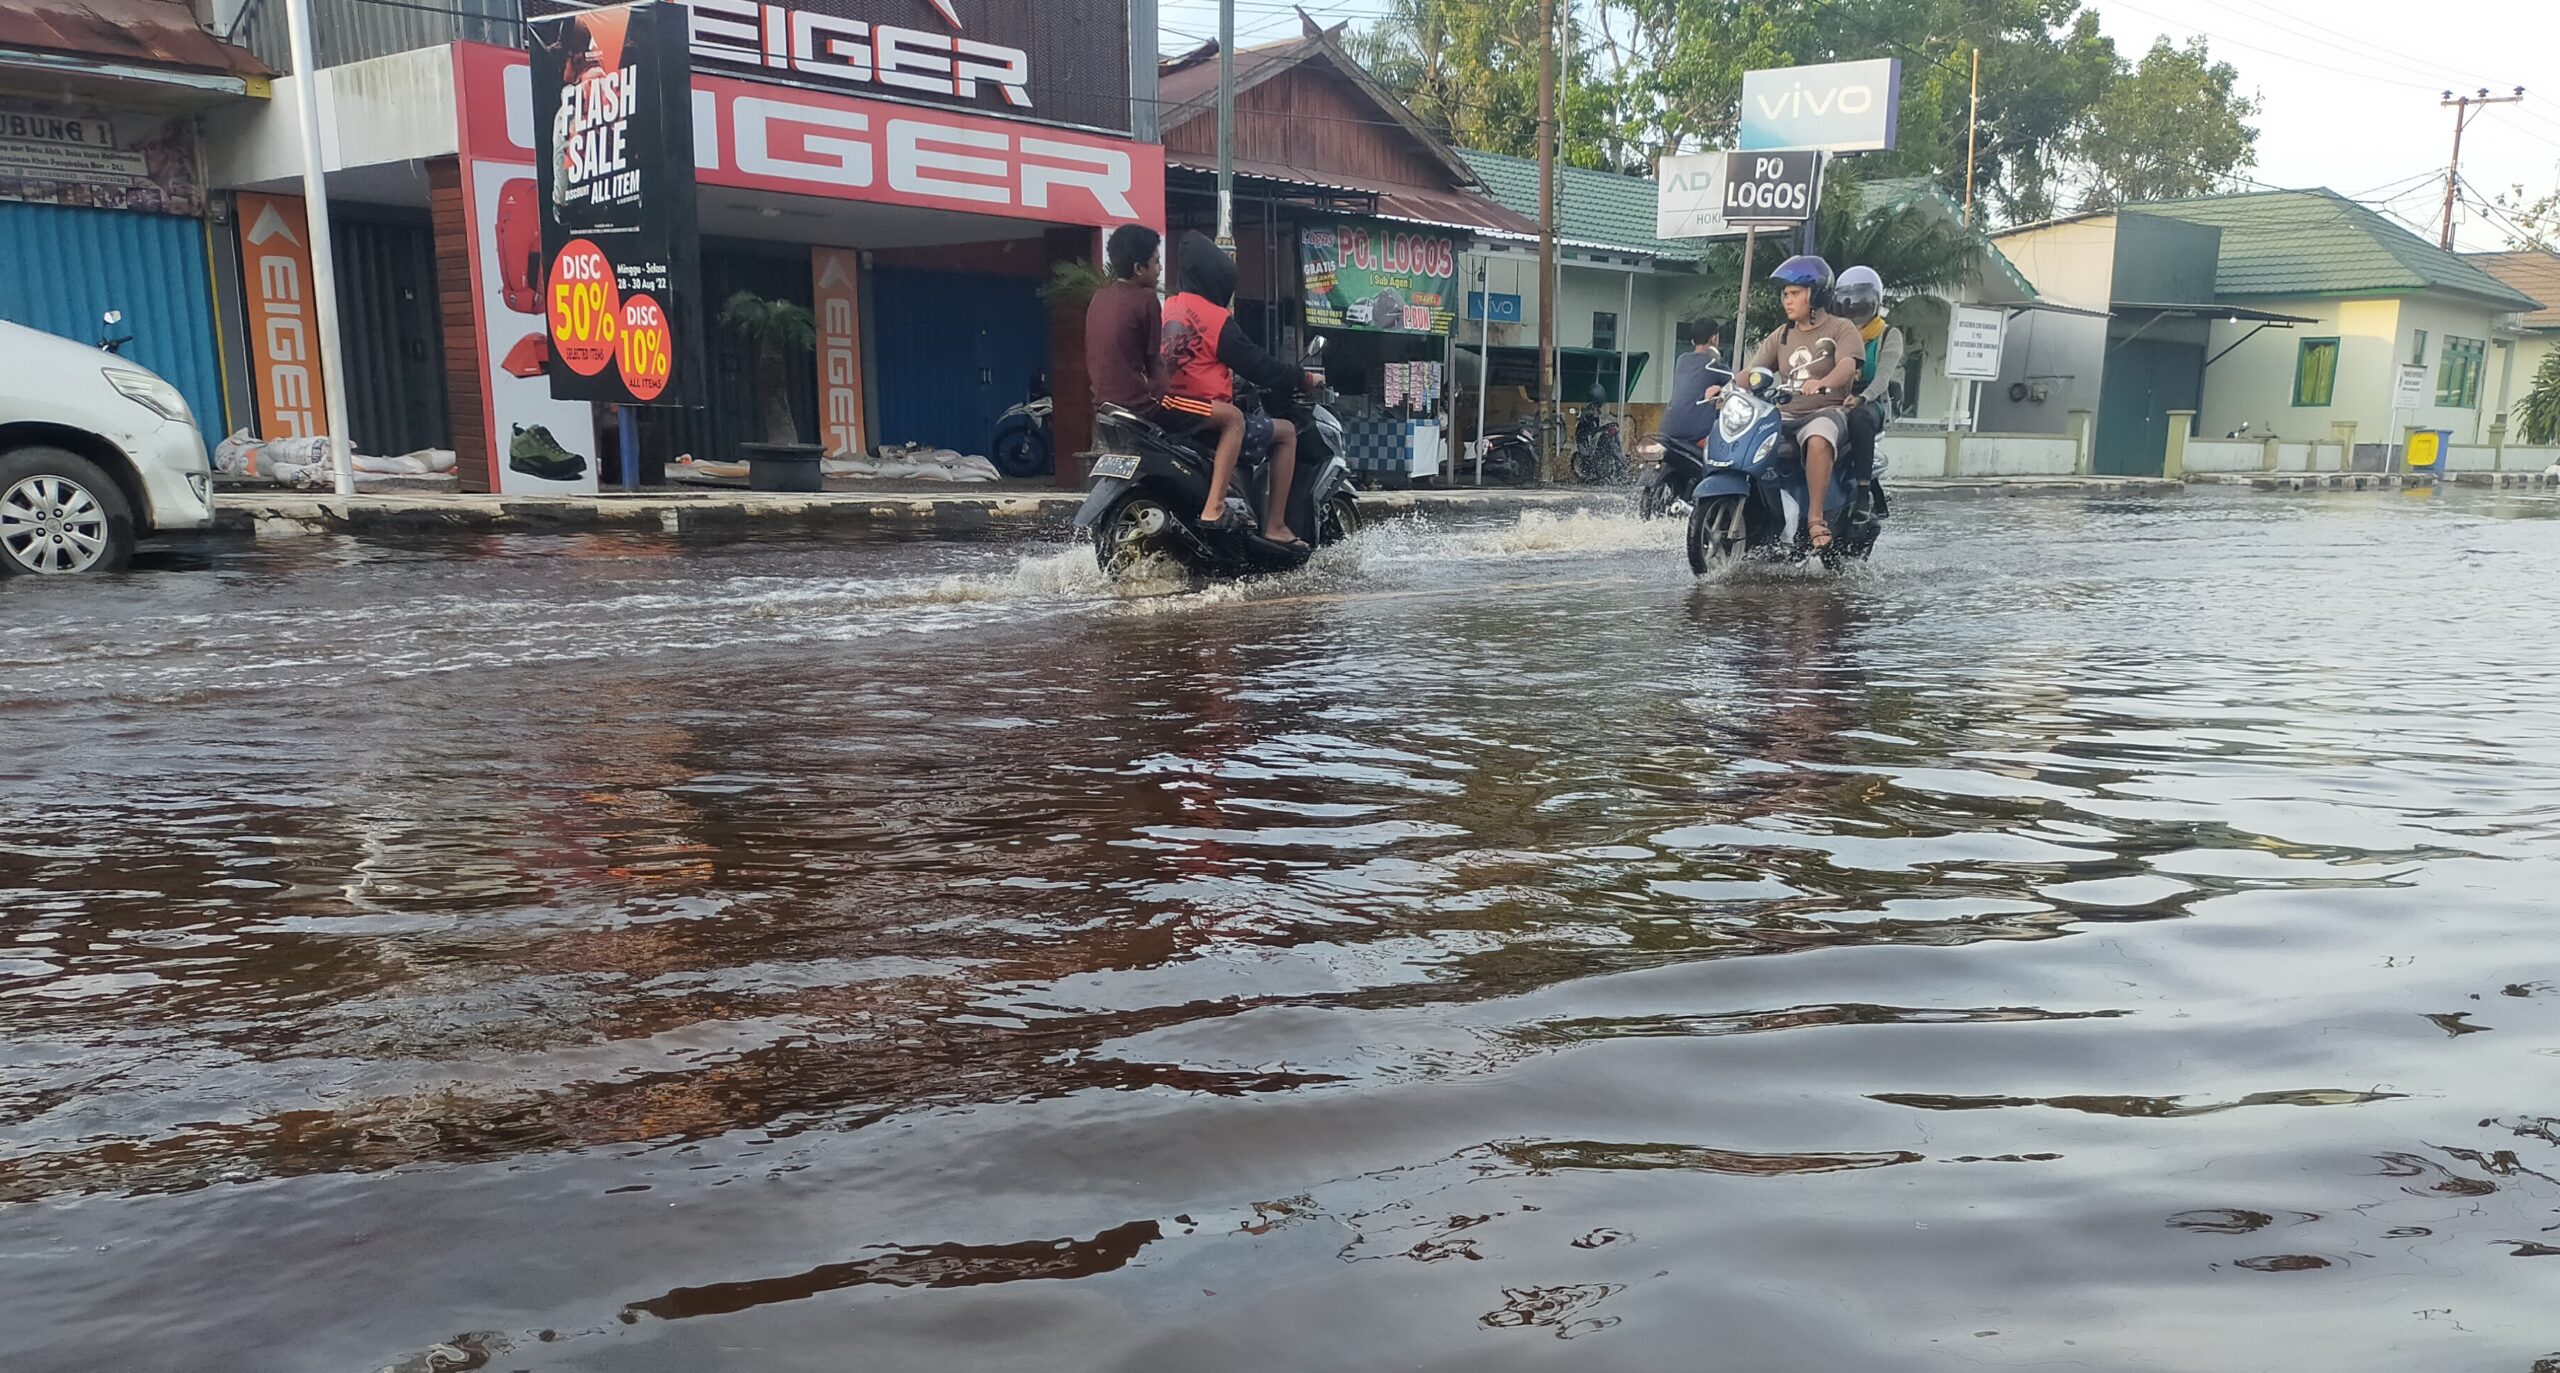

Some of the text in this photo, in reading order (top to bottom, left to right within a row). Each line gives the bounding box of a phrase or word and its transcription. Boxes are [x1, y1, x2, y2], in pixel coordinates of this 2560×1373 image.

[674, 0, 1033, 107] EIGER
[561, 64, 637, 136] FLASH
[1756, 80, 1872, 120] vivo
[503, 64, 1140, 219] IGER
[567, 120, 627, 184] SALE
[1755, 157, 1784, 180] PO
[591, 169, 641, 205] ALL ITEM
[1727, 181, 1807, 210] LOGOS
[1301, 228, 1336, 248] Logos
[1337, 225, 1454, 279] PO. LOGOS
[562, 254, 601, 280] DISC
[617, 263, 642, 277] Minggu
[645, 262, 667, 274] Selasa
[1304, 261, 1336, 276] GRATIS
[617, 278, 627, 289] 28
[631, 278, 642, 289] 30
[642, 278, 655, 292] Aug
[655, 277, 667, 289] '22
[555, 282, 615, 342] 50%
[627, 306, 658, 326] DISC
[1403, 304, 1431, 331] P.BUN
[620, 329, 667, 376] 10%
[629, 377, 662, 389] ALL ITEMS
[825, 298, 860, 458] EIGER
